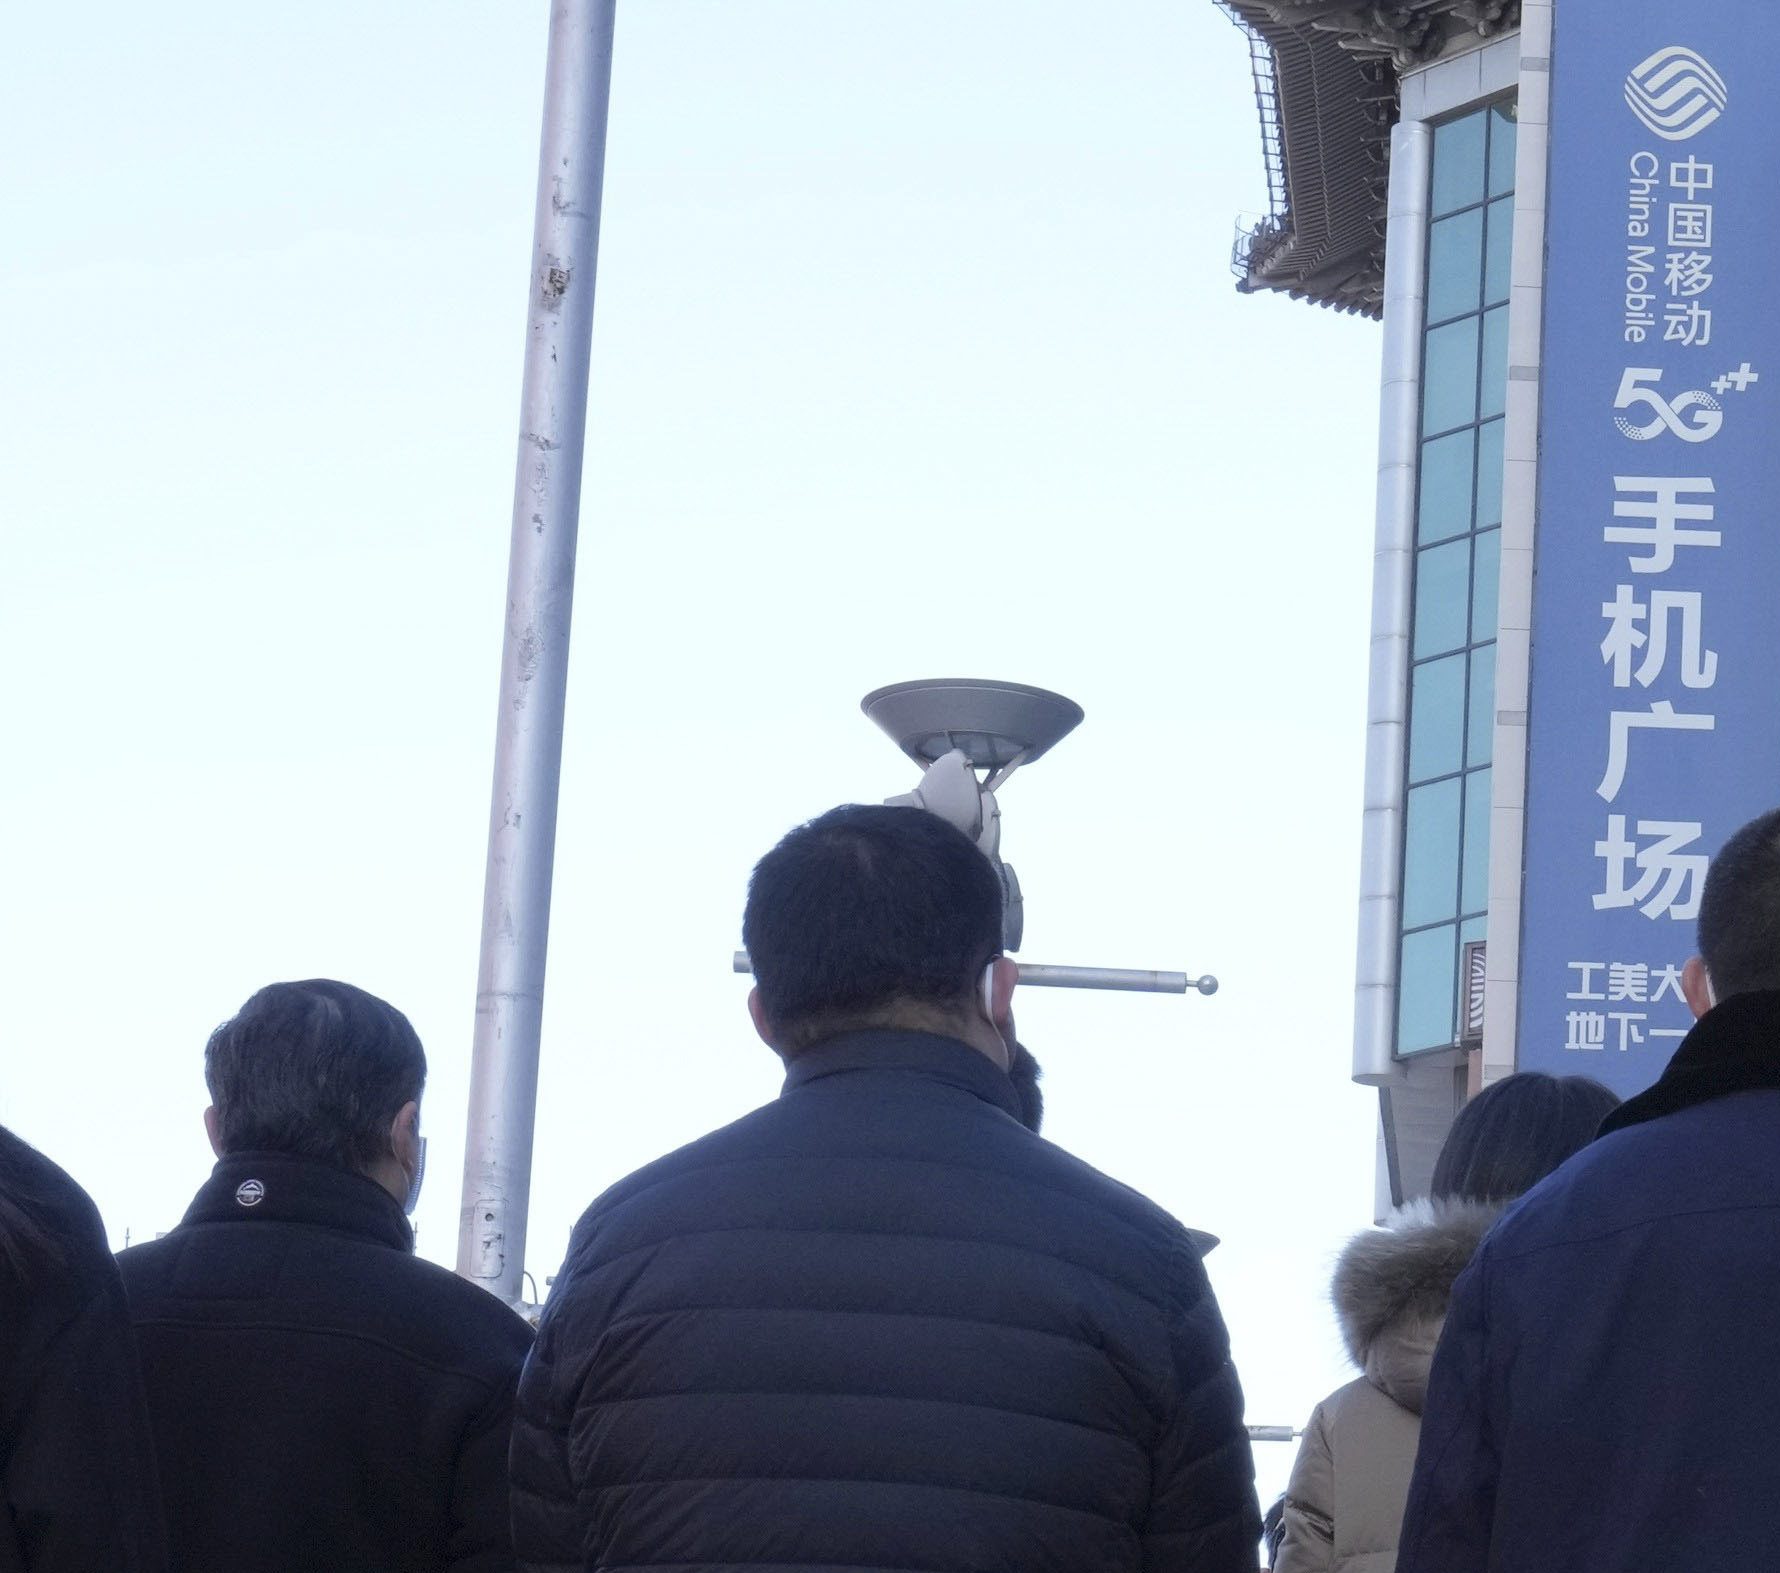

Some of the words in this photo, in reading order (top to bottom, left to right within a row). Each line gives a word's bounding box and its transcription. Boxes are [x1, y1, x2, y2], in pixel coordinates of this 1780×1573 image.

[1626, 151, 1660, 238] China
[1624, 244, 1656, 344] Mobile
[1663, 153, 1714, 347] 中国移动
[1592, 475, 1722, 922] 手机广场
[1565, 1011, 1697, 1051] 地下一
